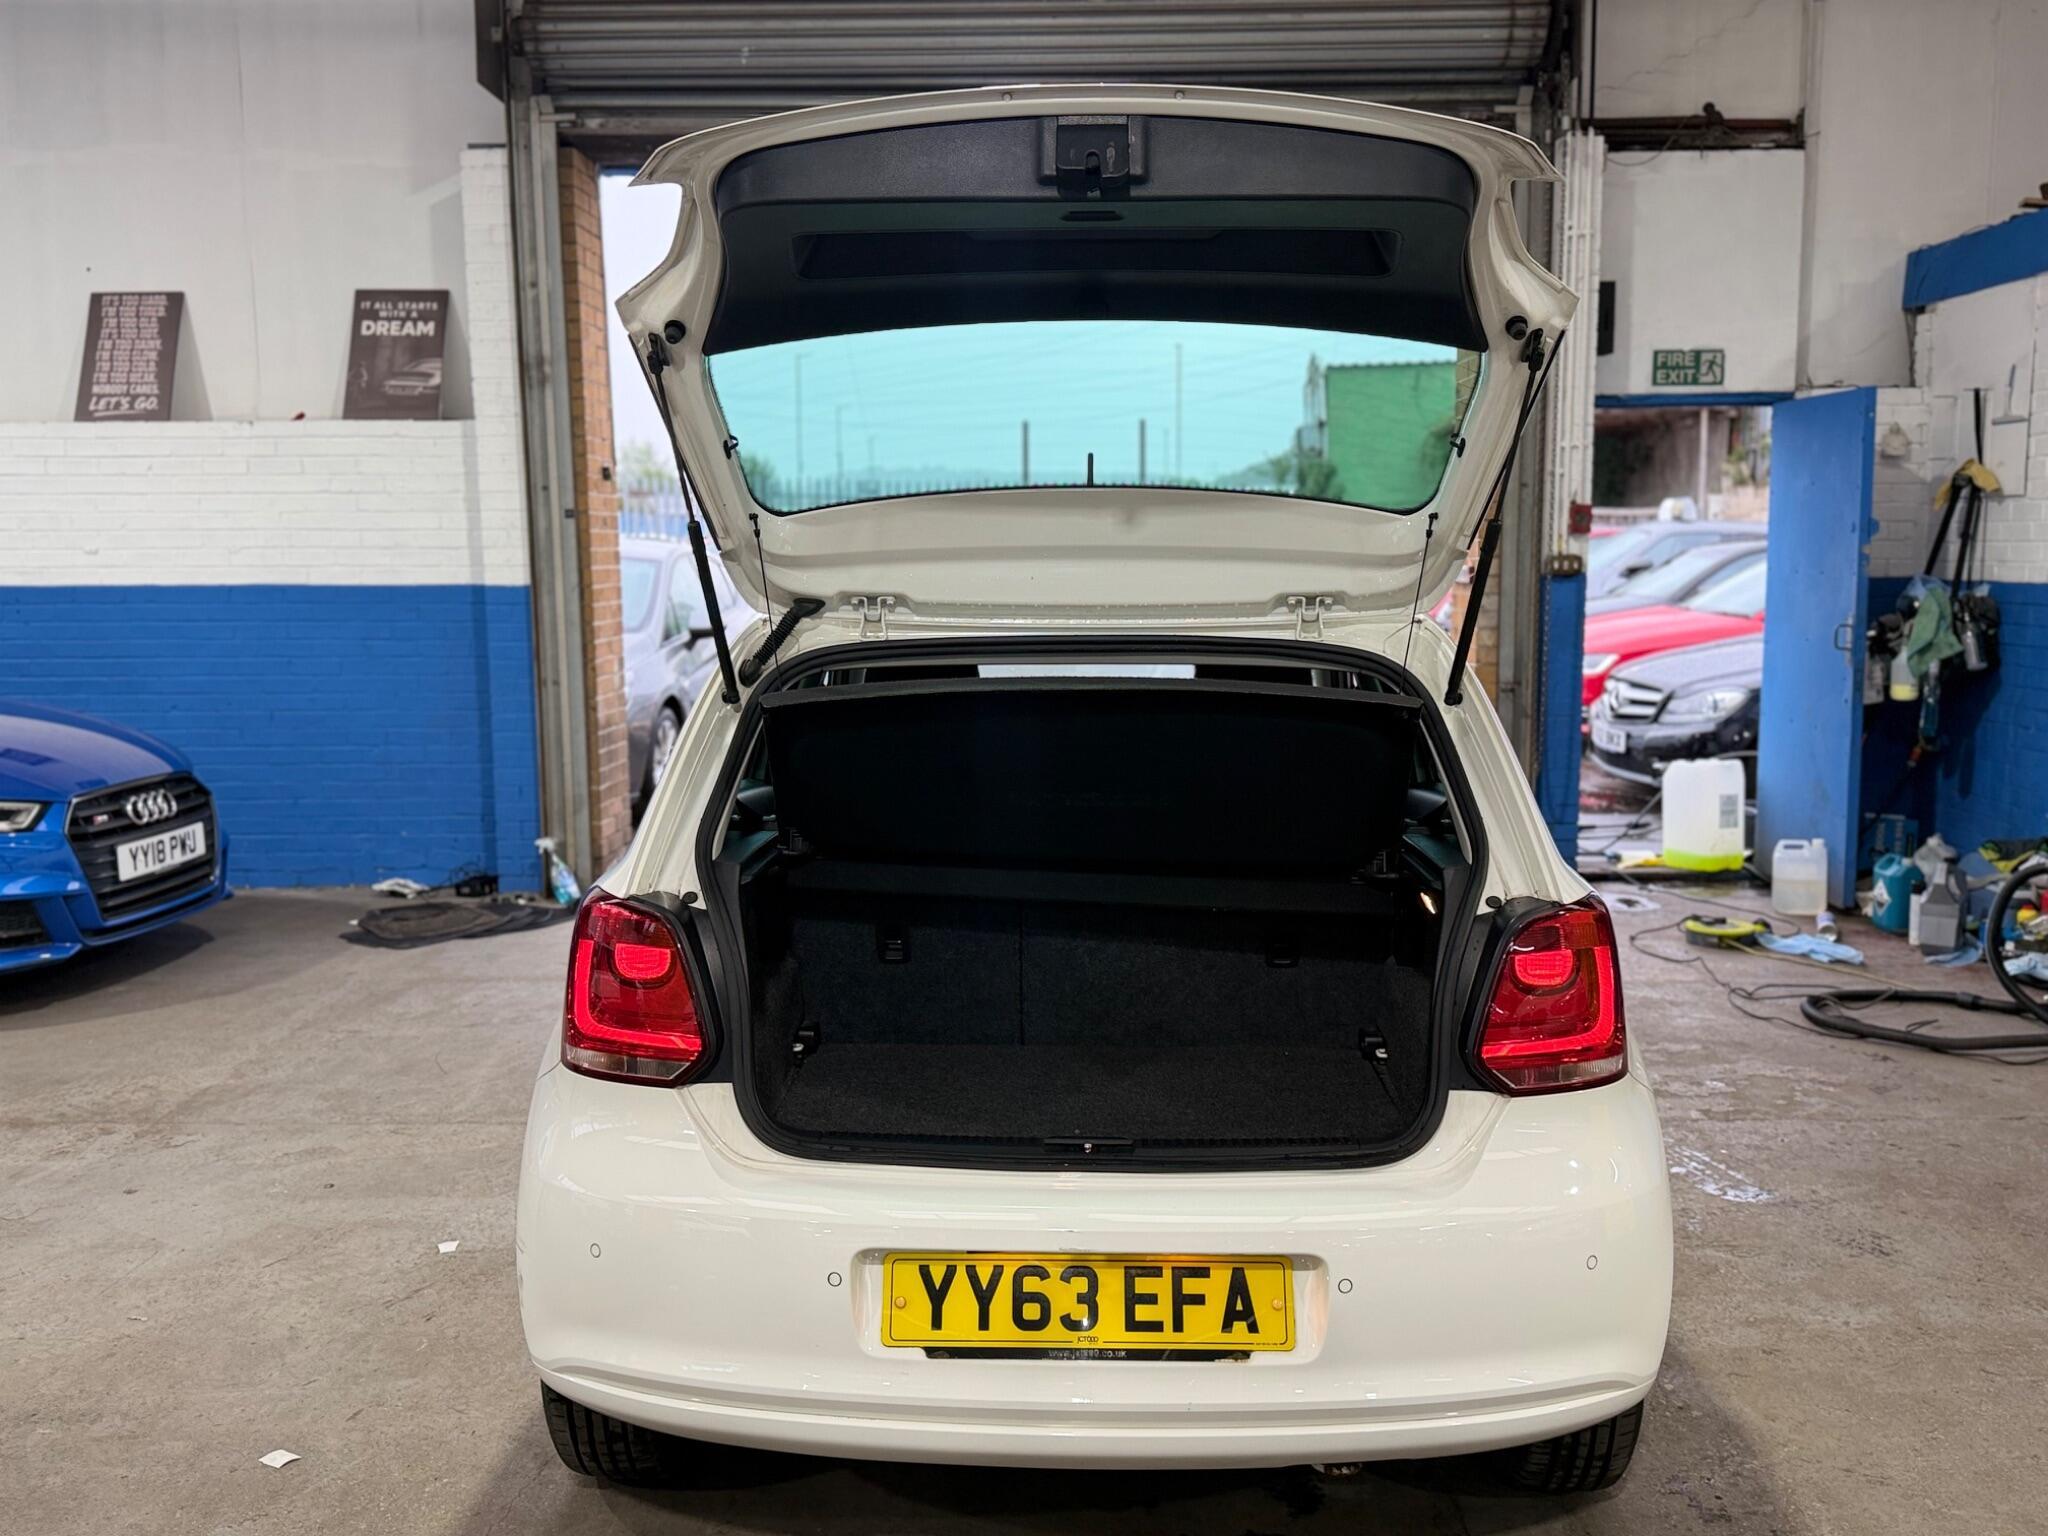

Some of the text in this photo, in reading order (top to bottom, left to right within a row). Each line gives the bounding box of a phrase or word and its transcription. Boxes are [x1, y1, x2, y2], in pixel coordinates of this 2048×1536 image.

[360, 301, 438, 311] IT ALL STARTS
[378, 310, 418, 319] WITH A
[360, 319, 436, 337] DREAM
[1656, 352, 1696, 367] FIRE
[1656, 369, 1696, 384] EXIT
[91, 384, 128, 394] NOBODY
[88, 396, 131, 411] LET'S
[129, 830, 198, 872] YY18 PWU
[918, 1264, 1260, 1334] YY63 EFA
